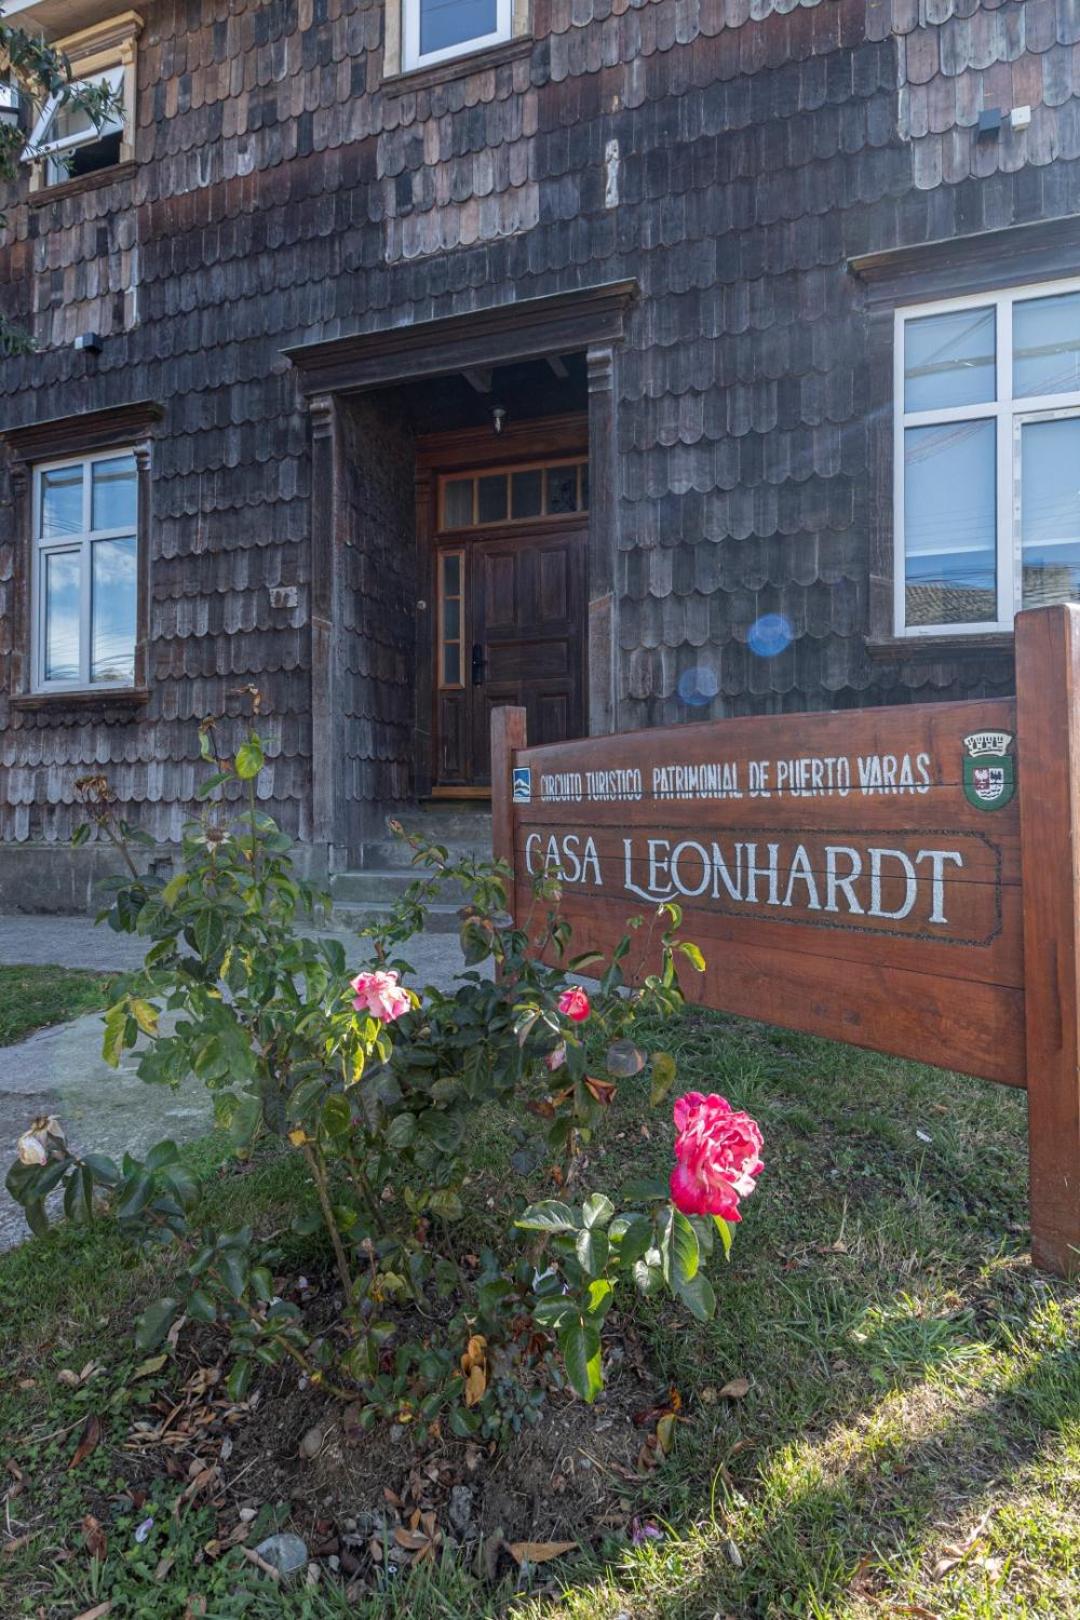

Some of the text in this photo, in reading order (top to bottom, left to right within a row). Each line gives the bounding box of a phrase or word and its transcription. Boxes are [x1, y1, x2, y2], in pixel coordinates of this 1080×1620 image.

[540, 752, 931, 802] CIRCUITO TURISTICO PATRIMONIAL DE PUERTO VARAS
[525, 833, 963, 924] CASA LEONHARDT
